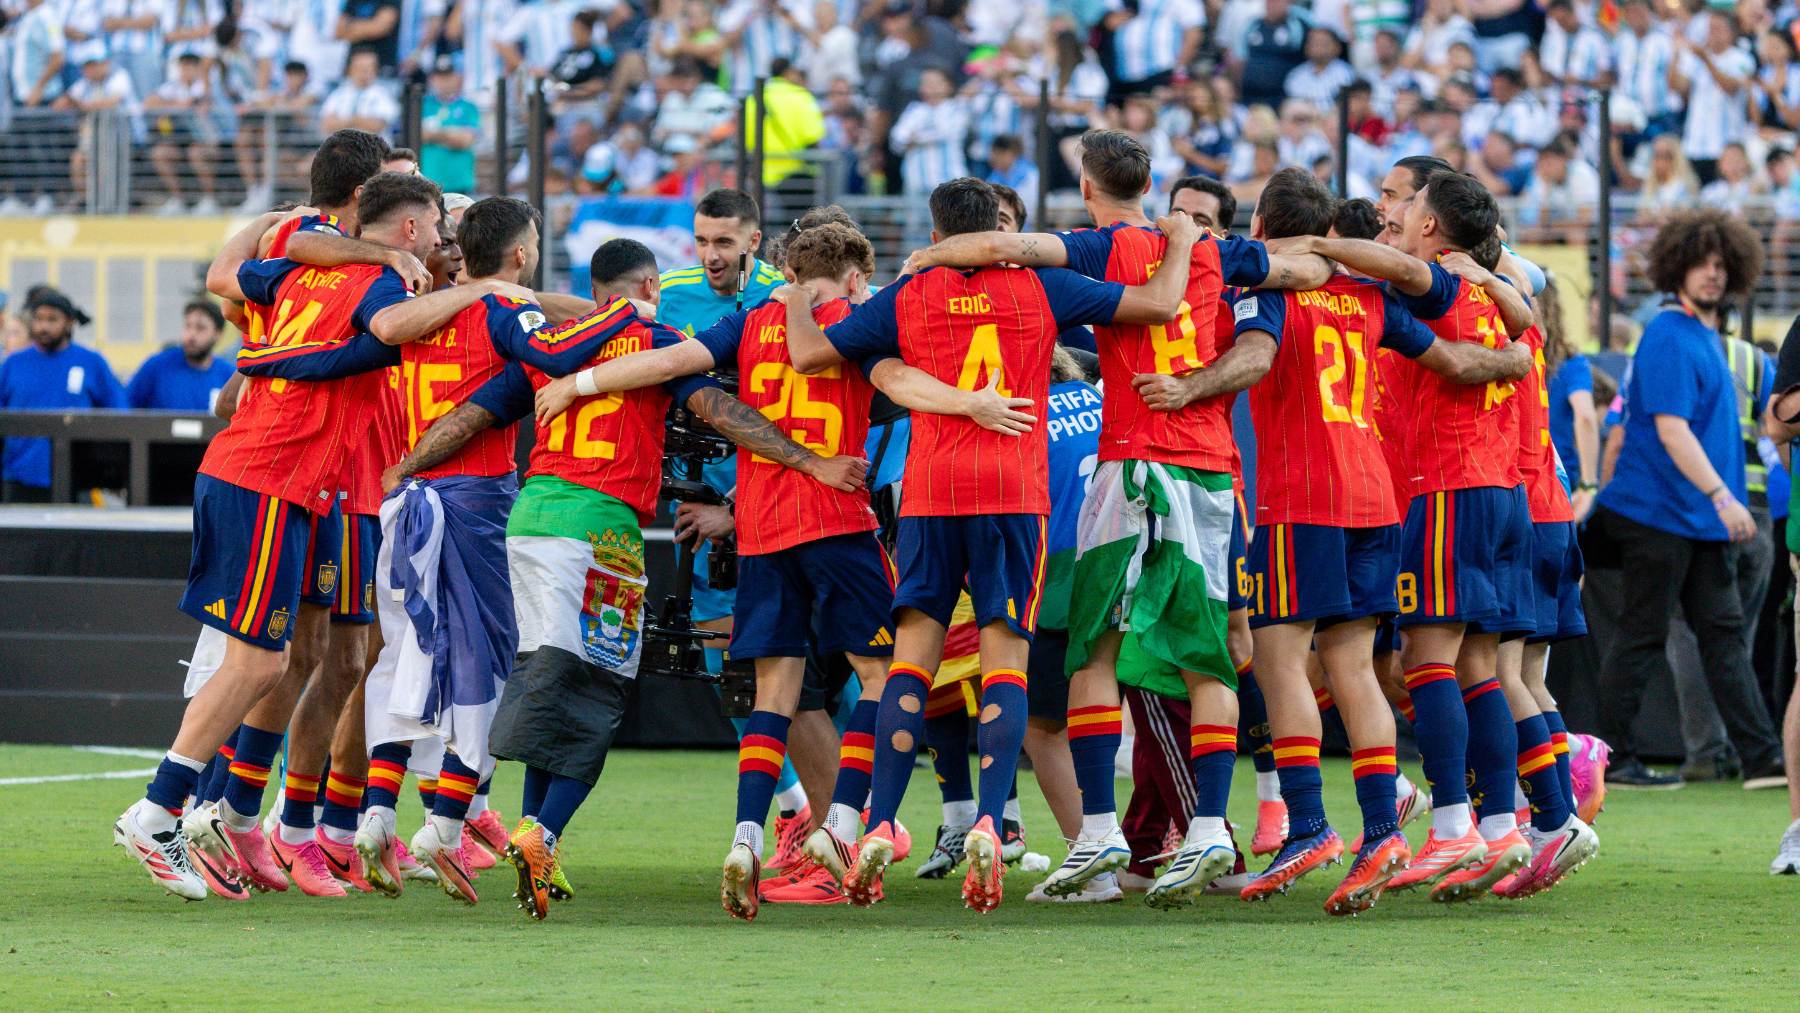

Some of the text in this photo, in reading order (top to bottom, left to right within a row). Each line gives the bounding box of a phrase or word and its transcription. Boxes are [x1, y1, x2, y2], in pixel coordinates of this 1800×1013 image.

[760, 324, 786, 344] VIC
[948, 293, 991, 315] ERIC
[956, 323, 1013, 399] 4
[1314, 323, 1369, 428] 21
[403, 360, 462, 452] 15
[547, 390, 625, 460] 12
[750, 362, 843, 465] 25
[1048, 388, 1101, 414] FIFA
[1393, 572, 1418, 614] 8
